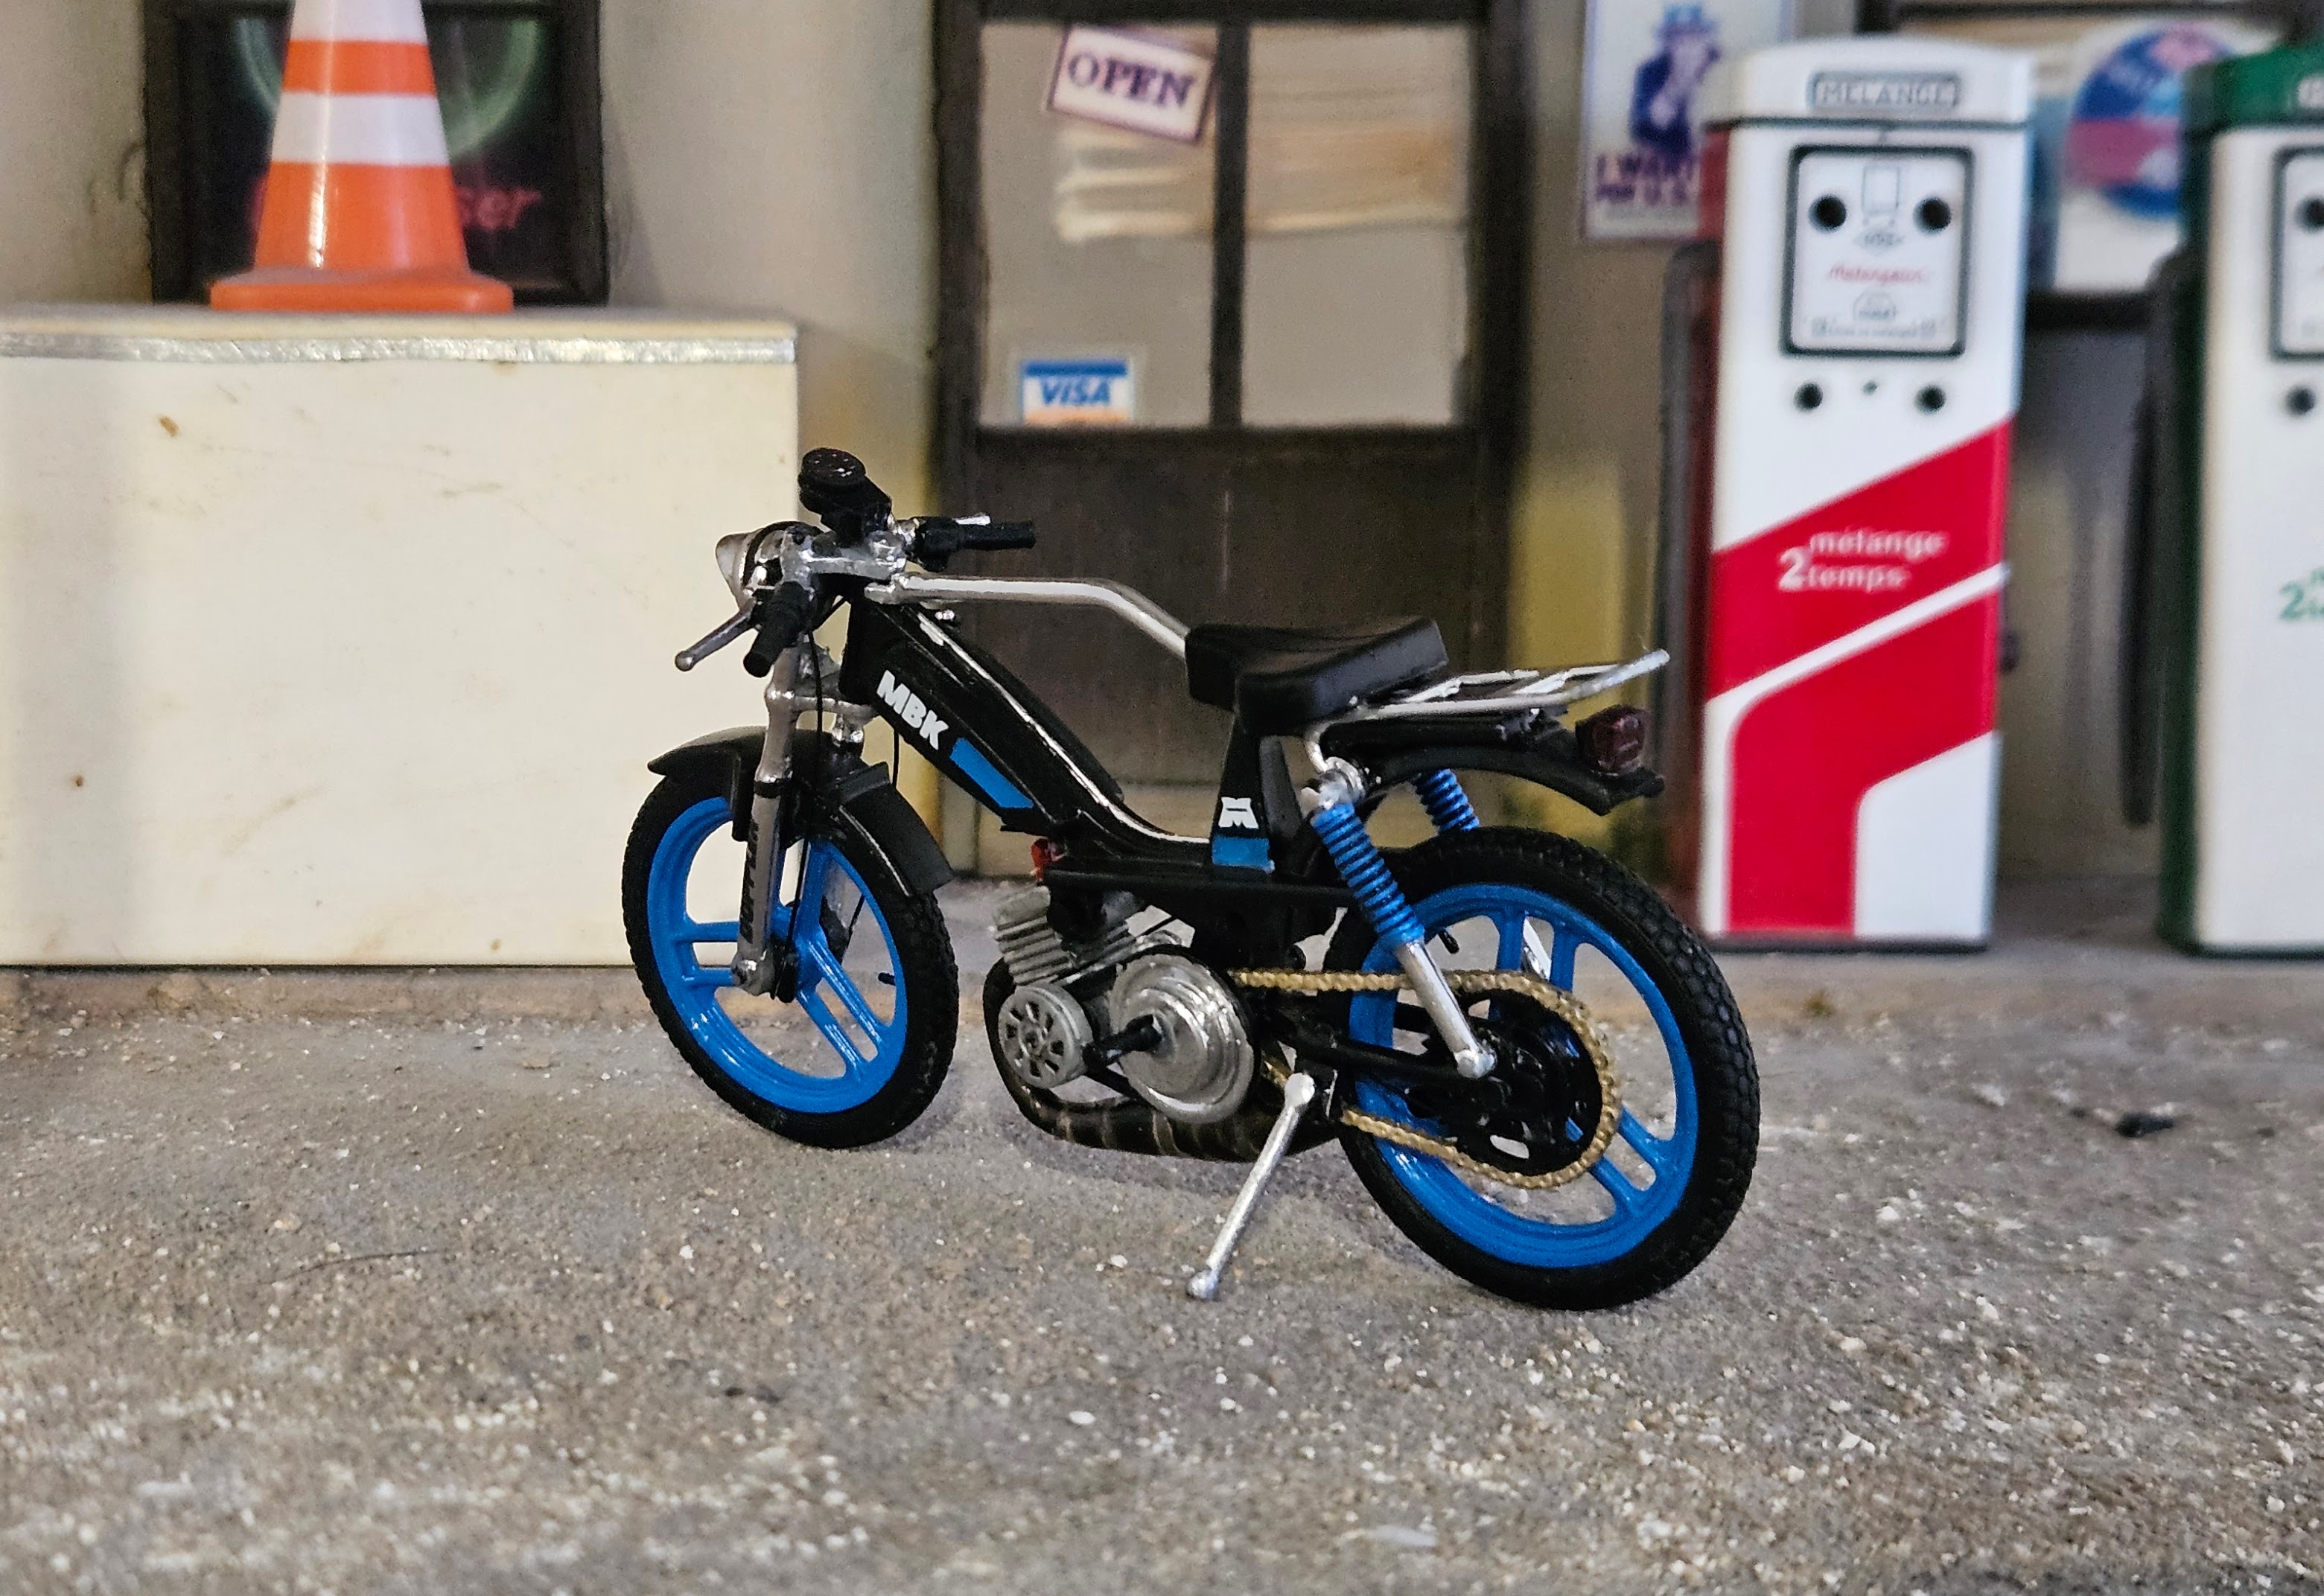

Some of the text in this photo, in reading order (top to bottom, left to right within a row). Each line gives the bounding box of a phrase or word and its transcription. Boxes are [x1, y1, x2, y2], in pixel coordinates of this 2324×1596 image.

[1068, 51, 1195, 107] OPEN
[1041, 377, 1112, 405] VISA
[1778, 546, 1910, 593] 2 temps
[876, 669, 949, 750] MBK
